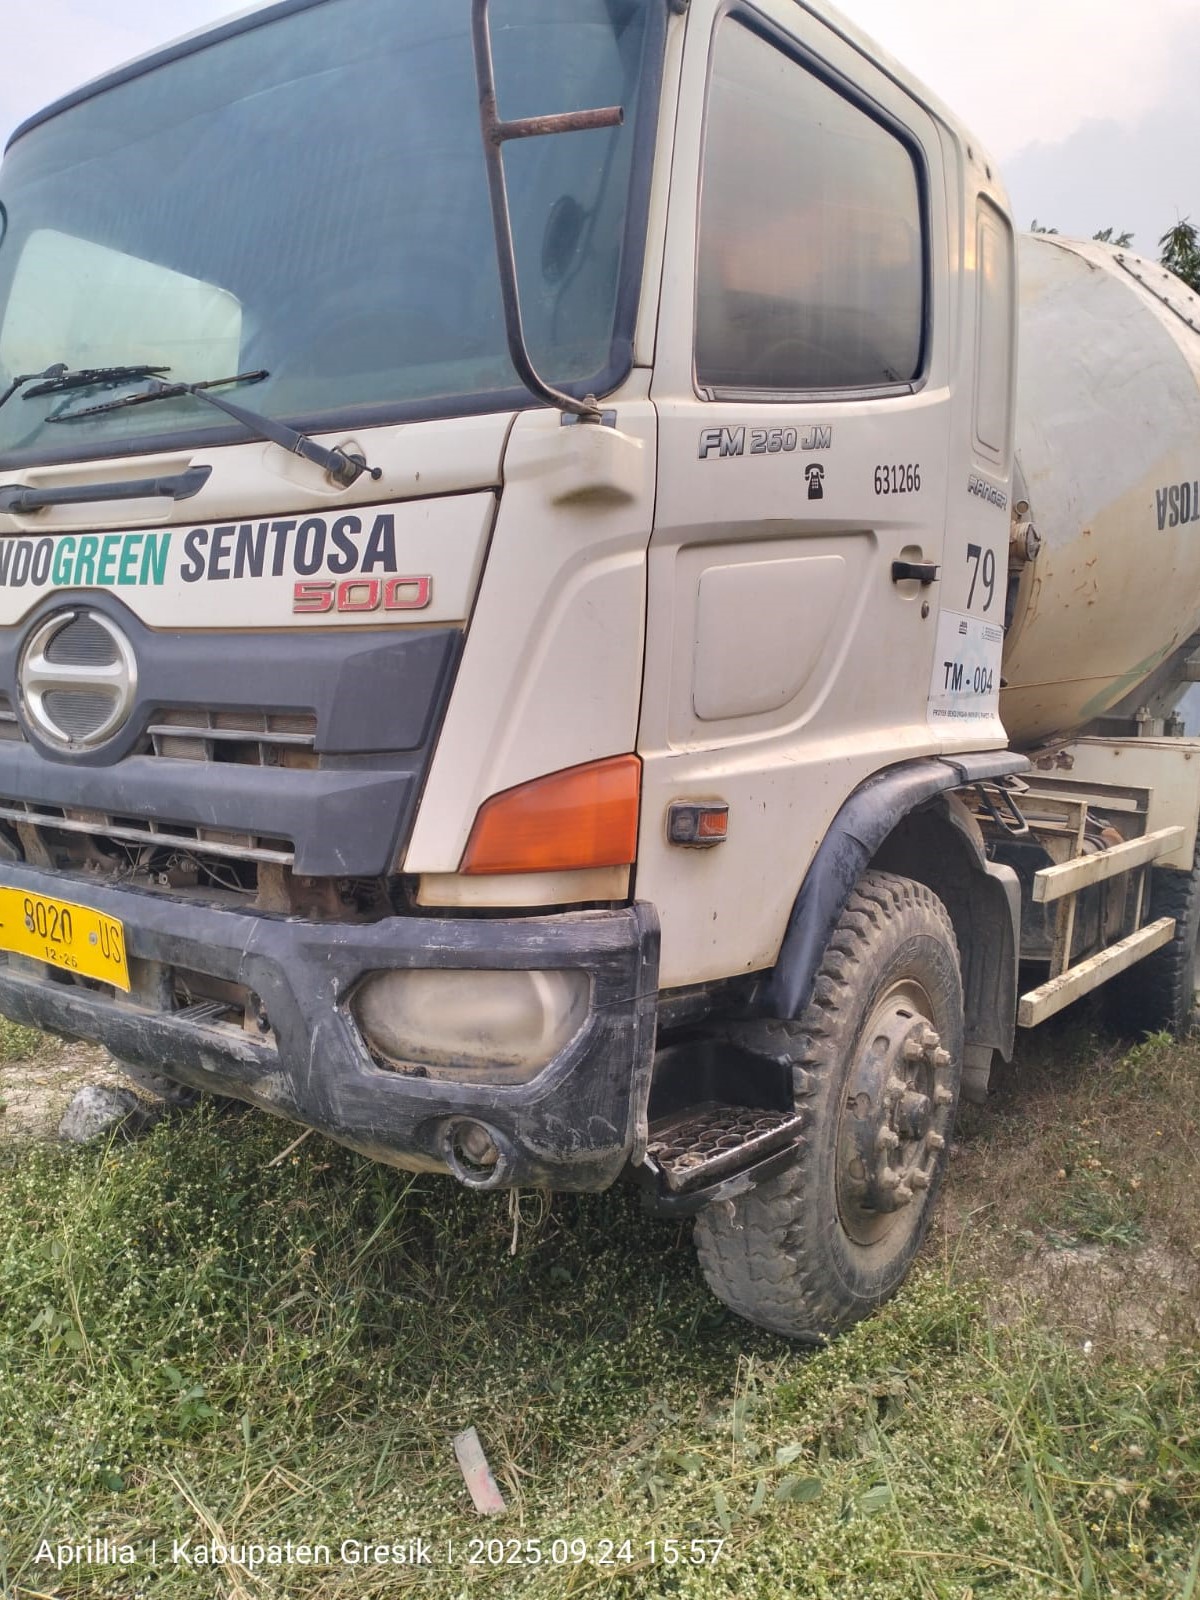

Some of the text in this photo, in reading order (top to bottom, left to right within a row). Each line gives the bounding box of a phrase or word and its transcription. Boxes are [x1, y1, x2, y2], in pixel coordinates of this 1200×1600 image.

[698, 426, 832, 459] FM 260 JM
[874, 464, 921, 494] 631266
[180, 514, 397, 583] SENTOSA
[293, 575, 432, 613] 500
[966, 543, 996, 612] 79
[943, 661, 964, 692] TM
[973, 666, 993, 694] 004
[24, 898, 122, 964] 8020 US
